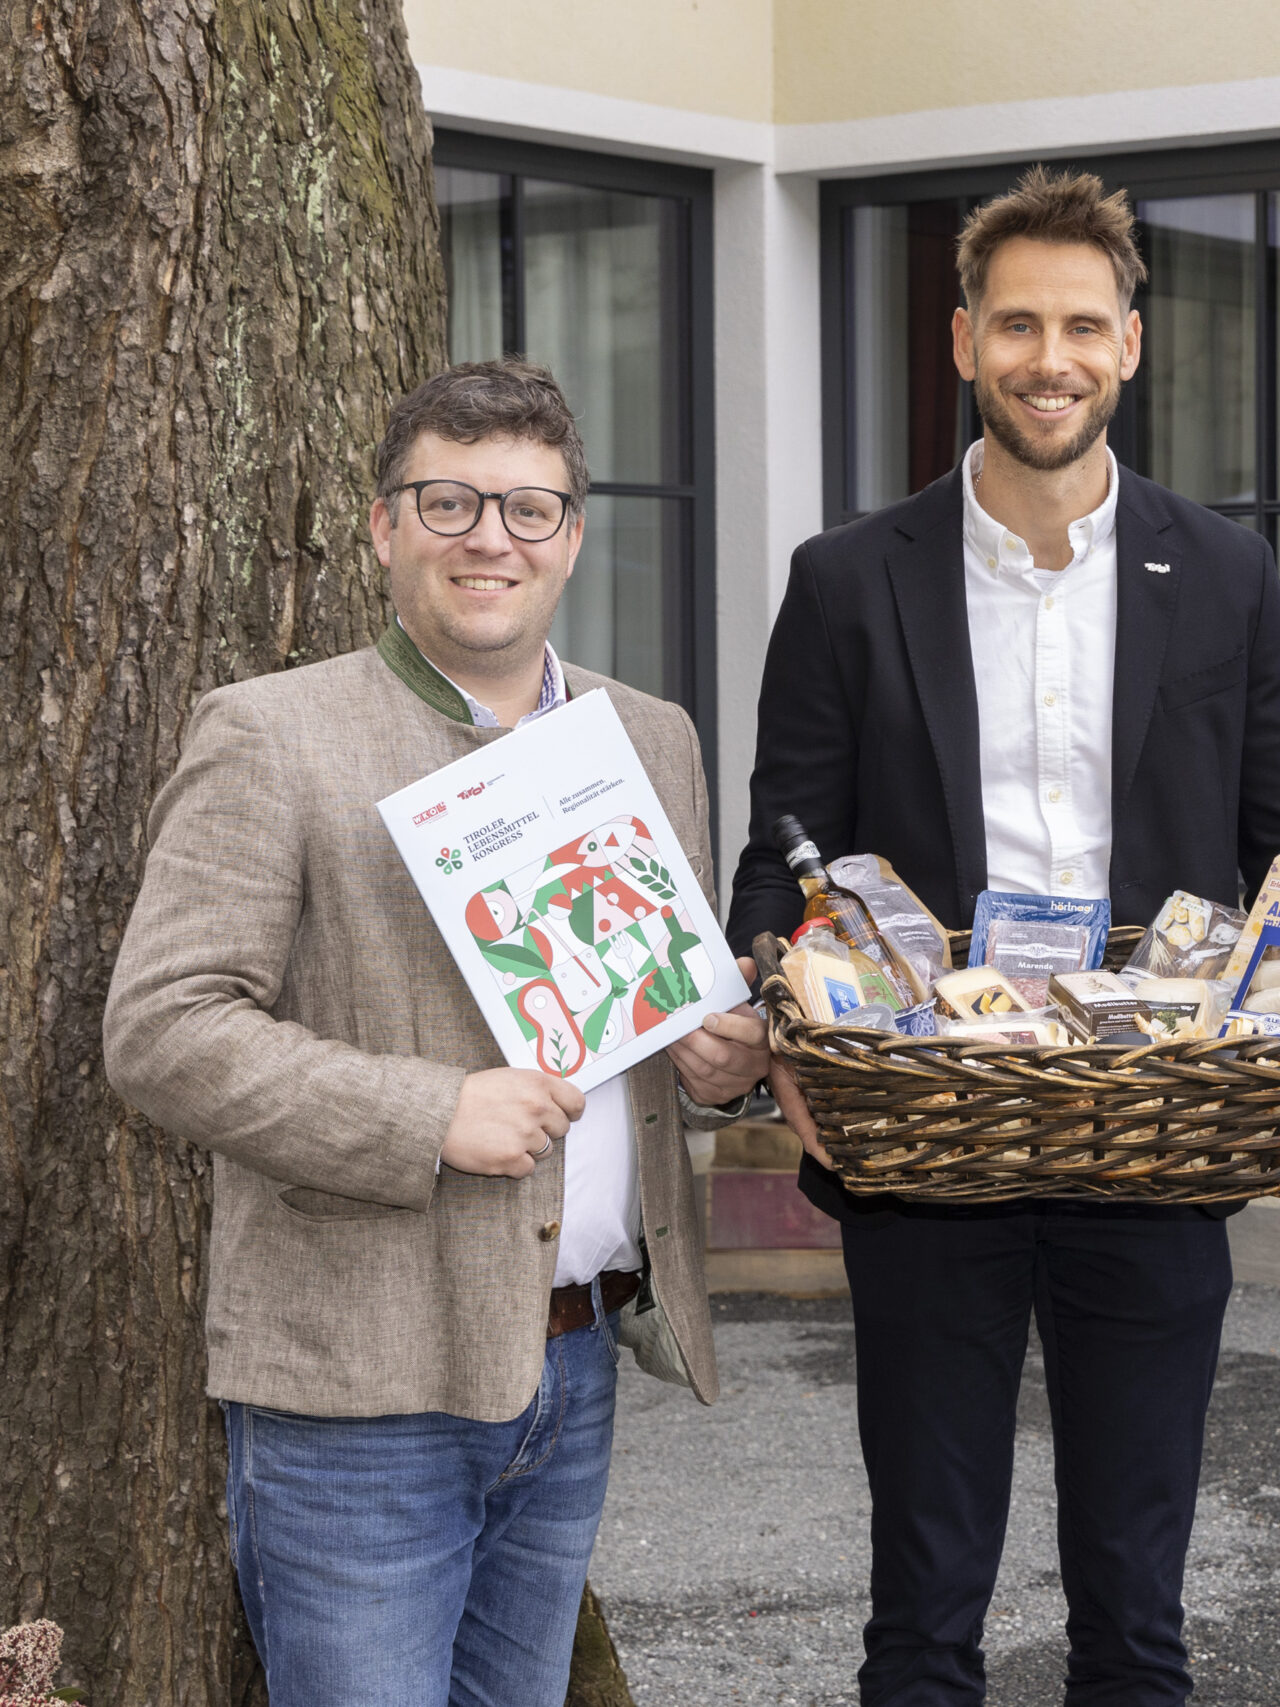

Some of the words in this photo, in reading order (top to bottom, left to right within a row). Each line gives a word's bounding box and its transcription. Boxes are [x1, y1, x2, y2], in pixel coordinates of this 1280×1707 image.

[559, 797, 572, 806] Alle
[463, 817, 506, 844] TIROLER
[467, 811, 540, 853] LEBENSMITTEL
[472, 829, 524, 862] KONGRESS
[1051, 901, 1094, 914] hörtnagl
